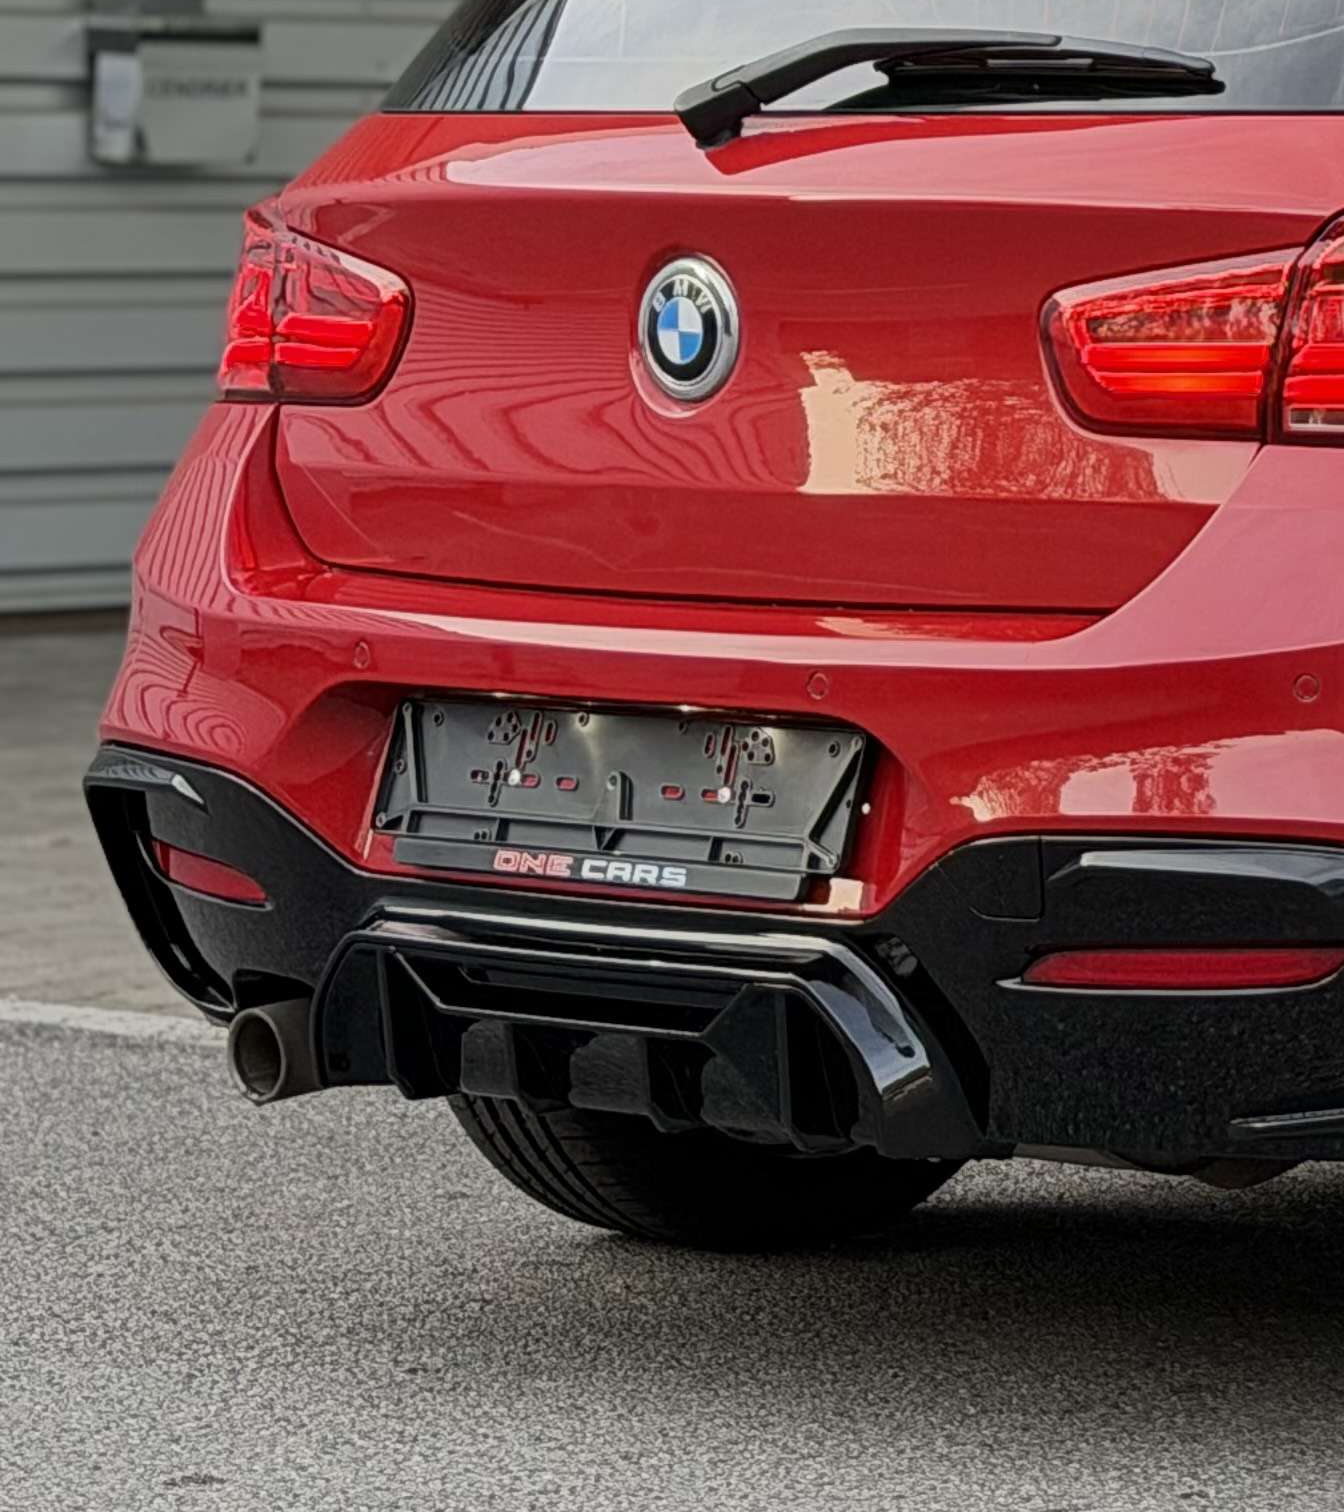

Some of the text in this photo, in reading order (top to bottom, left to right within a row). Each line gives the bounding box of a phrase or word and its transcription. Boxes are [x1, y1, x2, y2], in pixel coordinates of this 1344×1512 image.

[652, 277, 713, 314] BMW
[493, 849, 687, 887] ONE CARS
